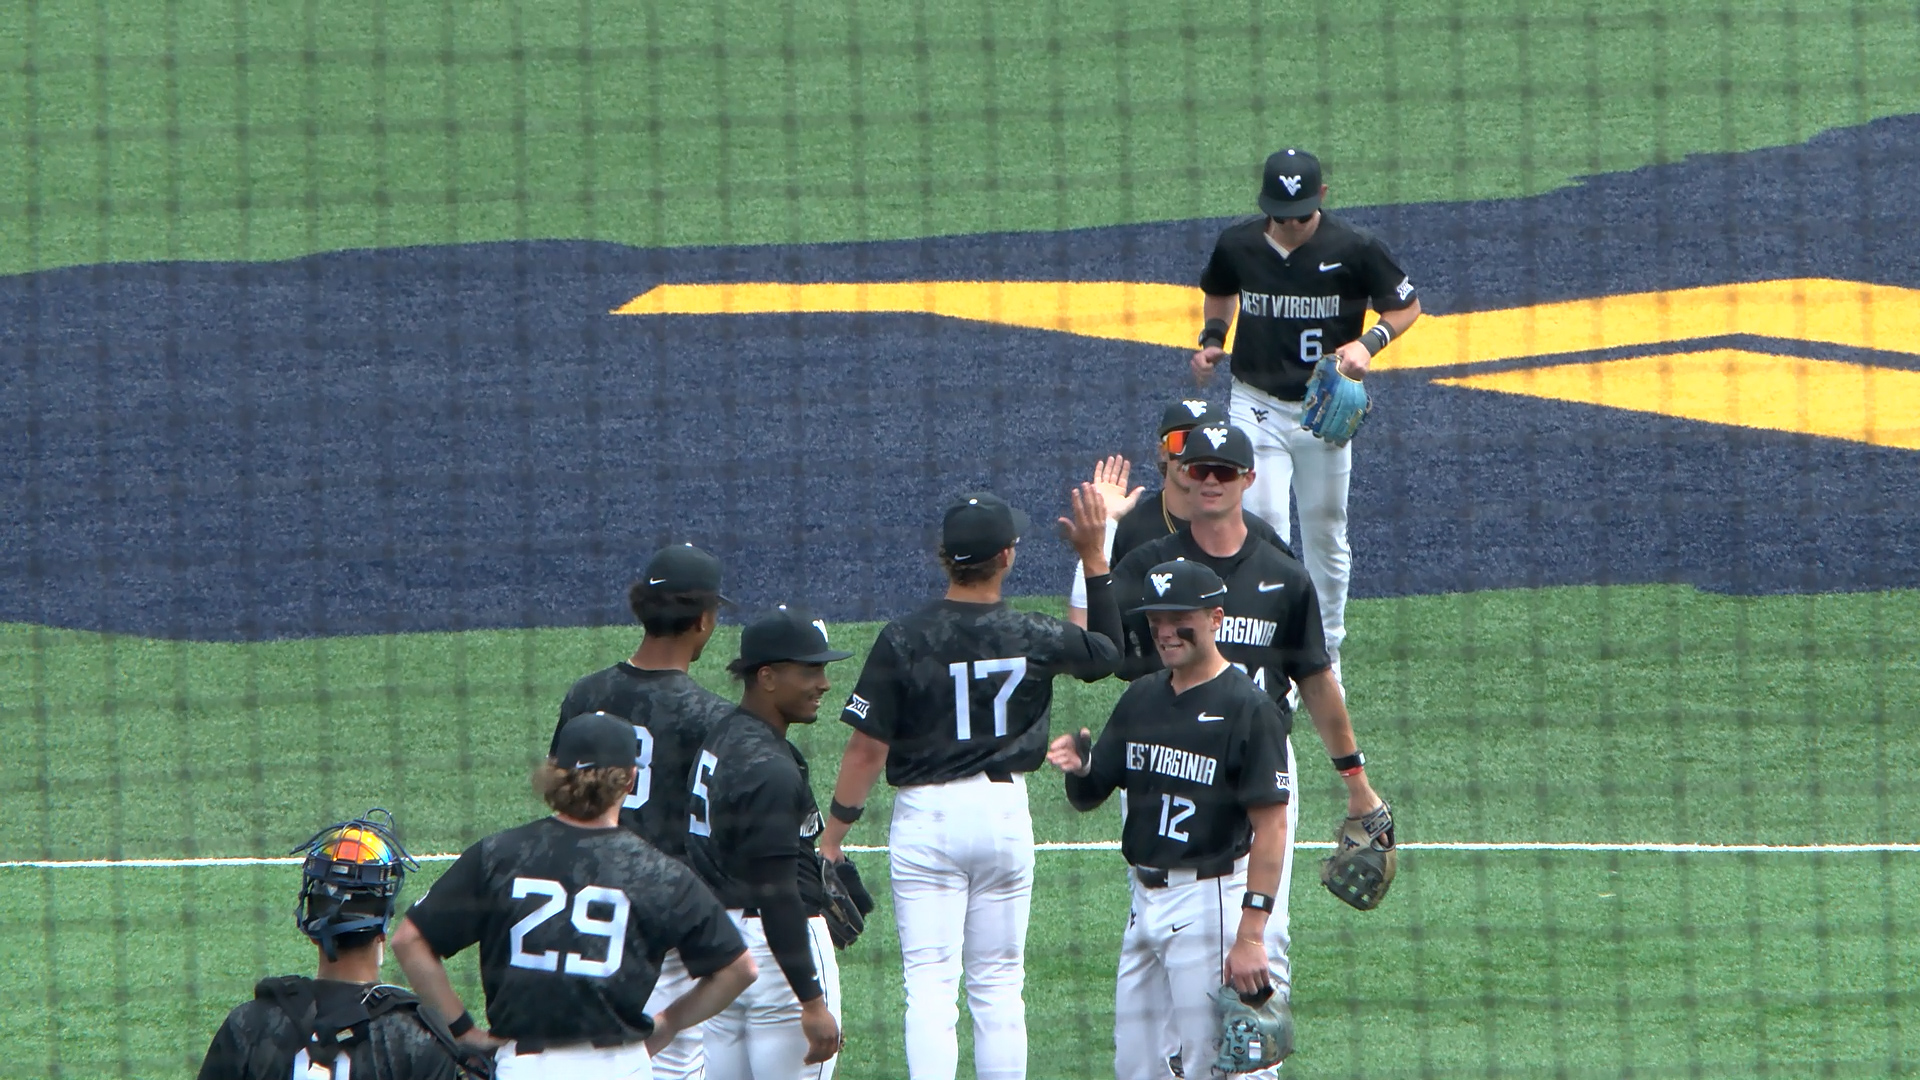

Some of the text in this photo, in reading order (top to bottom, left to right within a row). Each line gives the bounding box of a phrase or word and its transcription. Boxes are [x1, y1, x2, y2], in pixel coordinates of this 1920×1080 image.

[1241, 289, 1340, 319] WEST VIRGINIA
[1300, 328, 1323, 363] 6
[949, 657, 1027, 740] 17
[1149, 744, 1217, 786] VIRGINIA
[689, 750, 718, 838] 5
[1158, 793, 1196, 843] 12
[510, 877, 631, 978] 29
